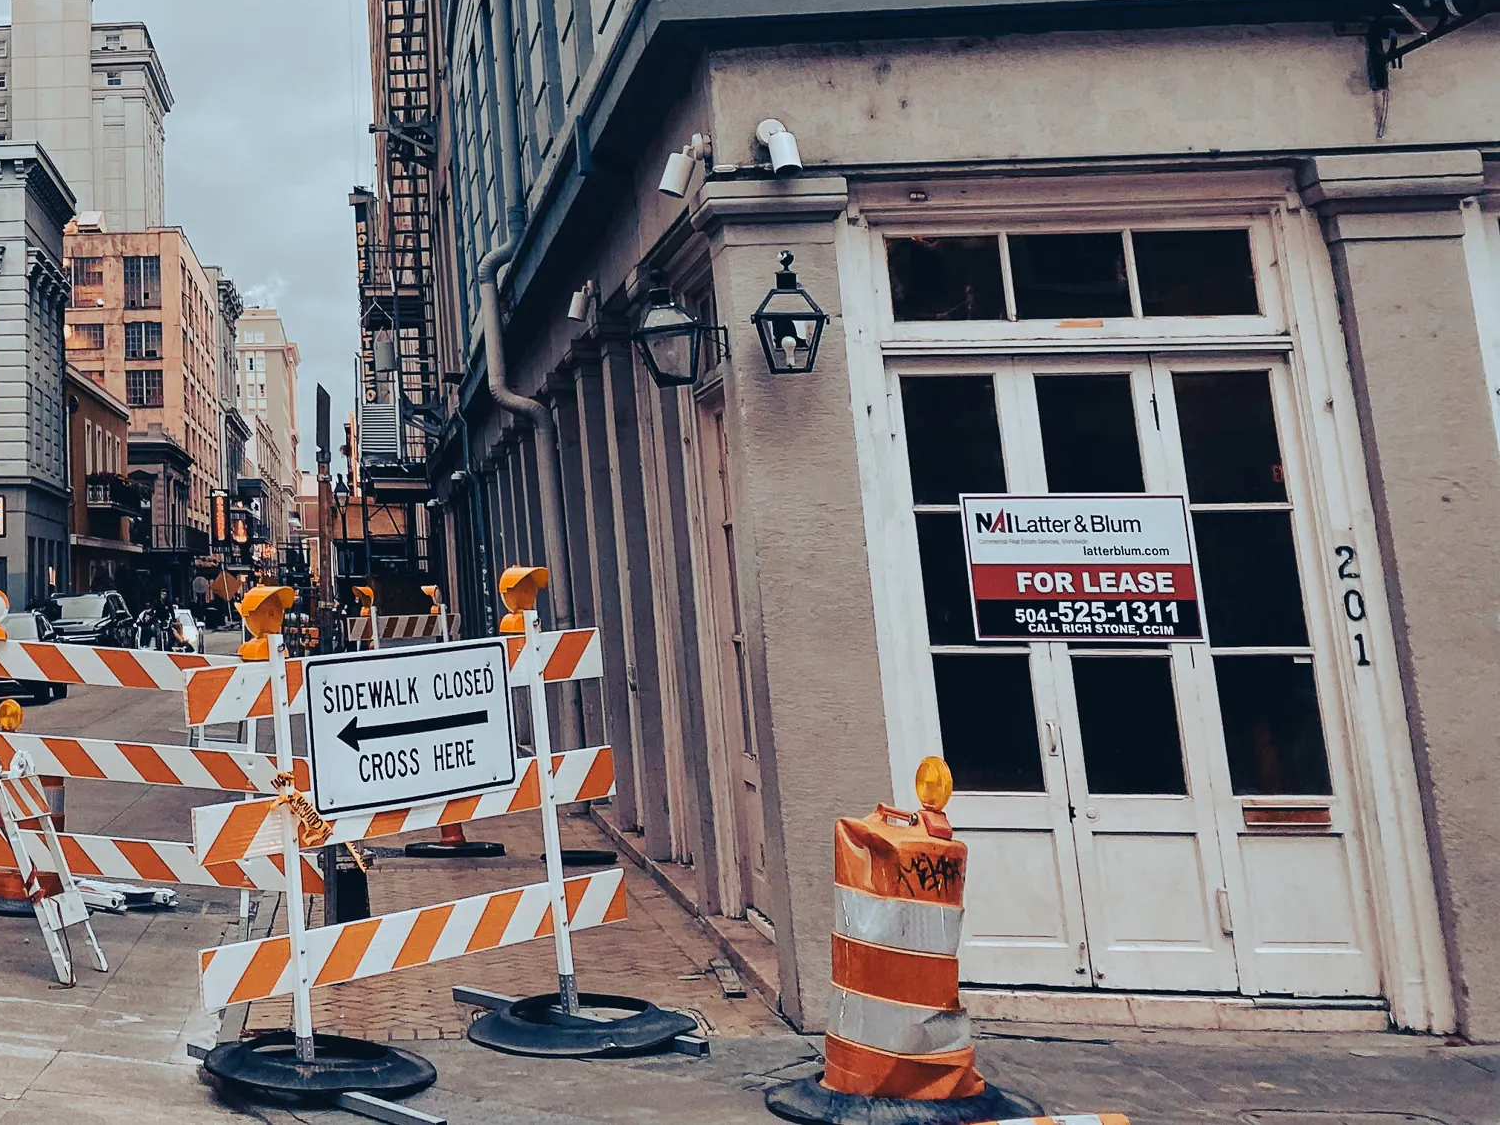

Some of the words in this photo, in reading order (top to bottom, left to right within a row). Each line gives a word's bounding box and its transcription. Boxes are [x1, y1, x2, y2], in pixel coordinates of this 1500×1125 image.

[975, 507, 1013, 534] NAI
[1014, 514, 1072, 533] Latter
[1074, 514, 1088, 533] &
[1090, 514, 1142, 533] Blum
[1082, 545, 1171, 557] latterblum.com
[1016, 571, 1076, 594] FOR
[1081, 571, 1176, 594] LEASE
[1015, 601, 1180, 624] 504-525-1311
[1334, 545, 1371, 667] 201
[1028, 623, 1060, 634] CALL
[1062, 623, 1093, 634] RICH
[1095, 624, 1140, 636] STONE,
[1142, 625, 1175, 636] CCIM
[323, 676, 420, 714] SIDEWALK
[433, 667, 495, 701] CLOSED
[358, 747, 420, 783] CROSS
[433, 739, 476, 772] HERE
